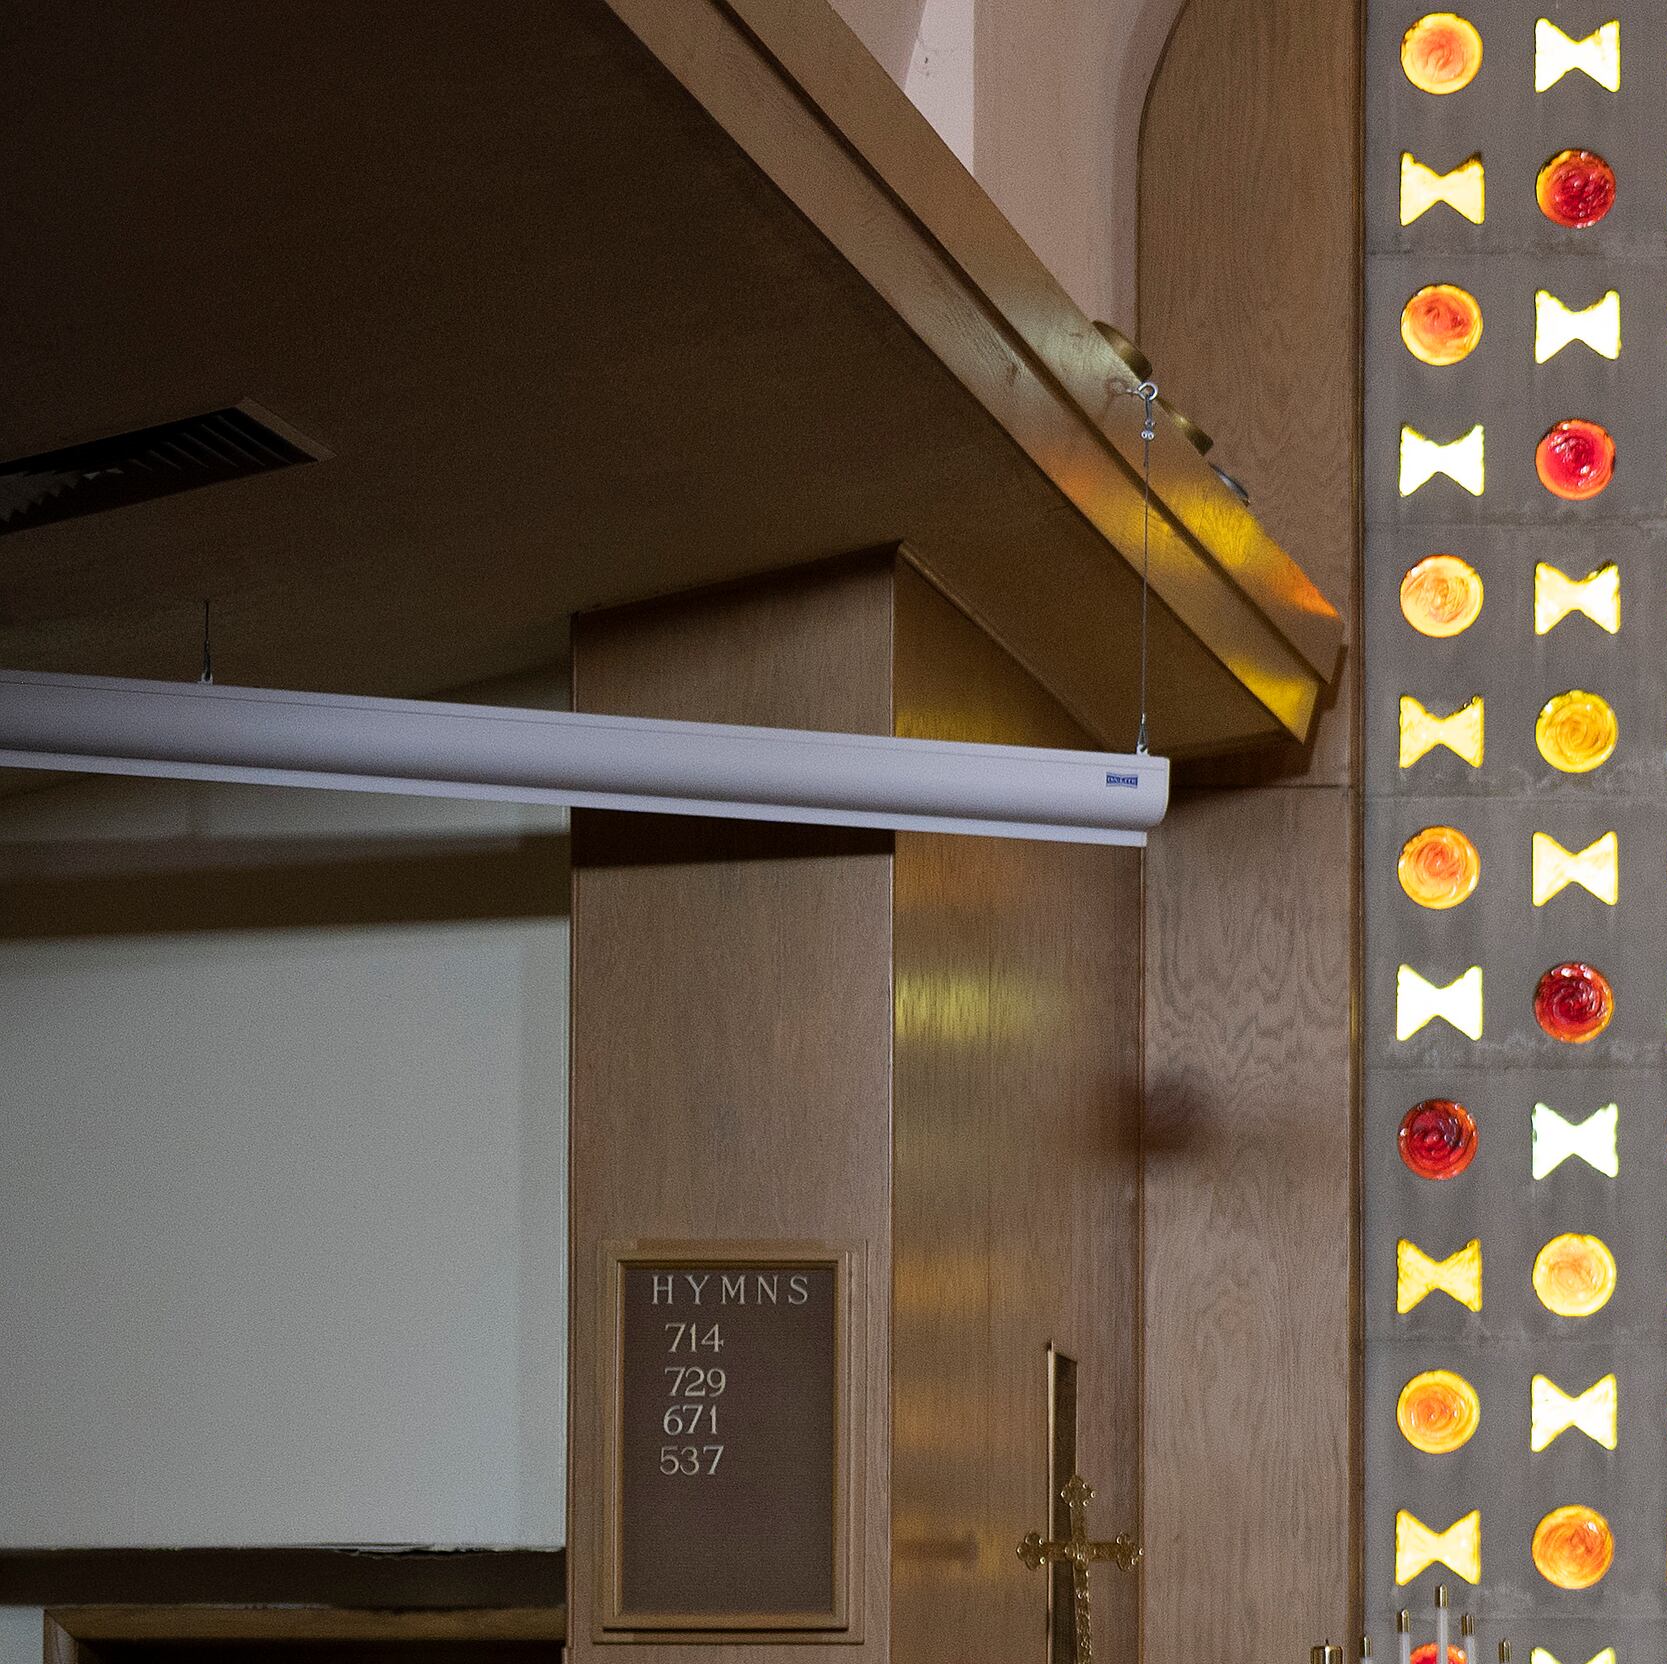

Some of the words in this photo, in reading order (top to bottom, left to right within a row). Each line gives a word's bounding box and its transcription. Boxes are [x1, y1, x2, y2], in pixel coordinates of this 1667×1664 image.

[651, 1274, 809, 1305] HYMNS
[665, 1322, 725, 1354] 714
[664, 1367, 727, 1398] 729
[662, 1404, 718, 1436] 671
[659, 1445, 725, 1476] 537
